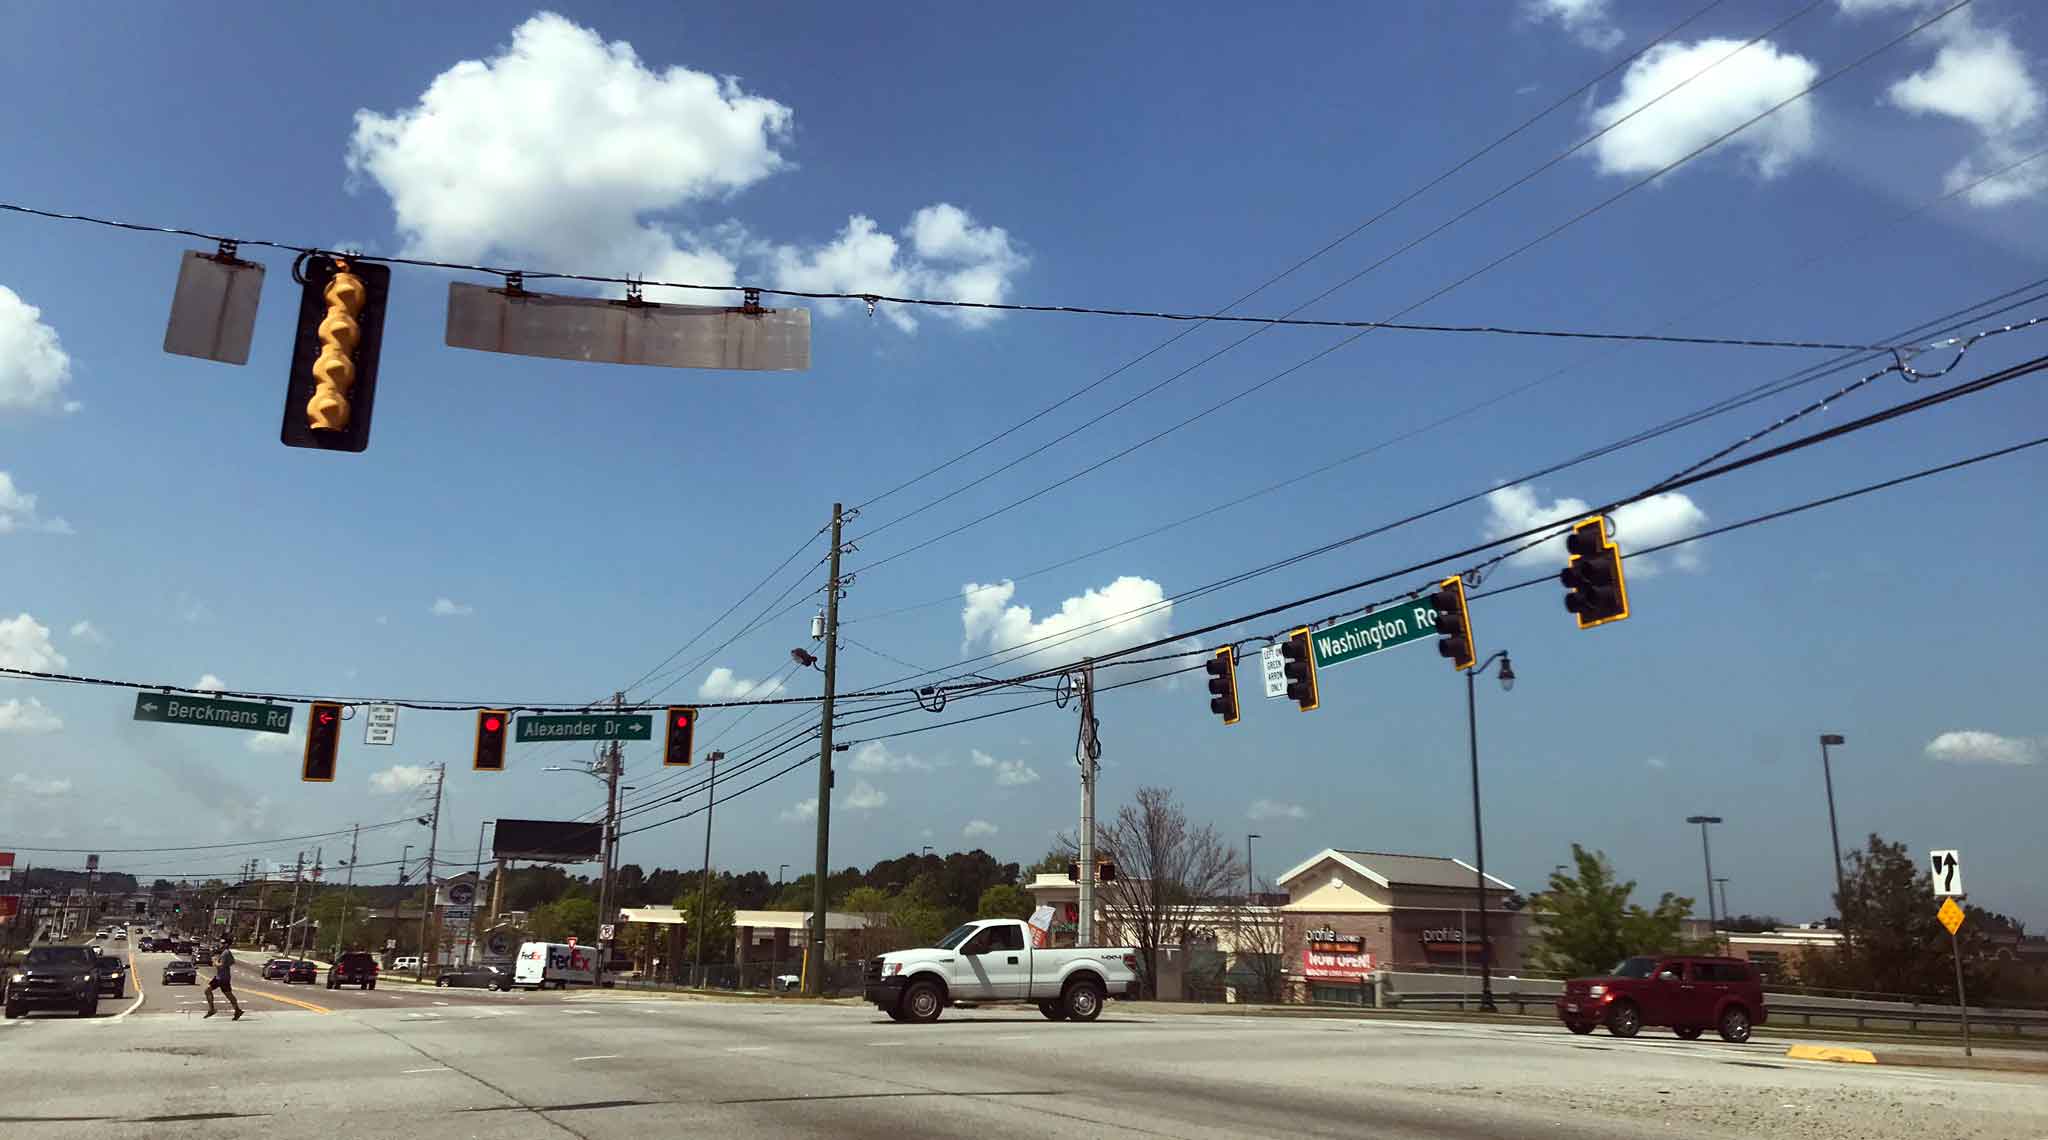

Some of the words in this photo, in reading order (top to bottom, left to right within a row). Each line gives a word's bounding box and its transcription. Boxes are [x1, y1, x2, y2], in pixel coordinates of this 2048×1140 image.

[1318, 619, 1408, 658] Washington
[1267, 660, 1282, 670] GREEN
[1268, 671, 1283, 681] ARROW
[1271, 683, 1283, 692] ONLY
[167, 701, 259, 725] Berckmans
[266, 710, 288, 728] Rd
[524, 720, 597, 737] Alexander
[604, 720, 621, 735] Dr
[521, 951, 541, 961] FedEx
[549, 946, 591, 973] FedEx
[1309, 951, 1335, 966] NOW
